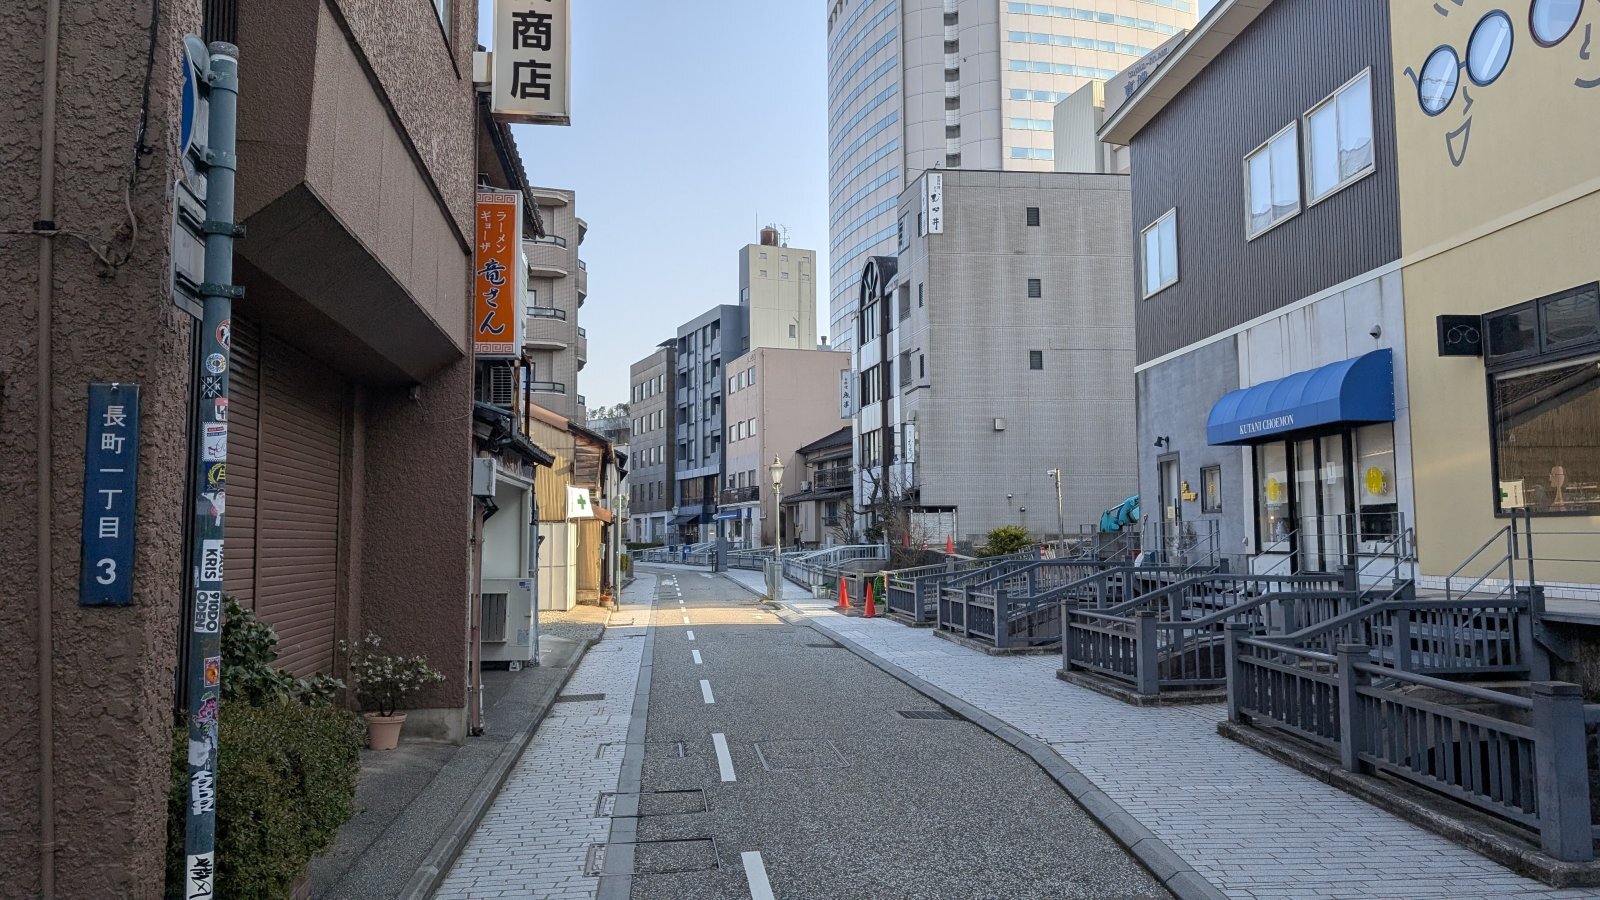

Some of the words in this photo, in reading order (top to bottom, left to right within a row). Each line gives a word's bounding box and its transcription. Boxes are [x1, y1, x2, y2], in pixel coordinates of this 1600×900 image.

[511, 0, 552, 100] 商店
[480, 210, 491, 253] ギョーザ
[496, 211, 507, 254] ラーメン
[477, 258, 506, 335] 竜さん
[1240, 421, 1261, 435] KUTANI
[1262, 414, 1294, 430] CHOEMON
[204, 548, 218, 579] KRIS
[195, 591, 208, 631] ODEN
[206, 592, 220, 632] 910DO
